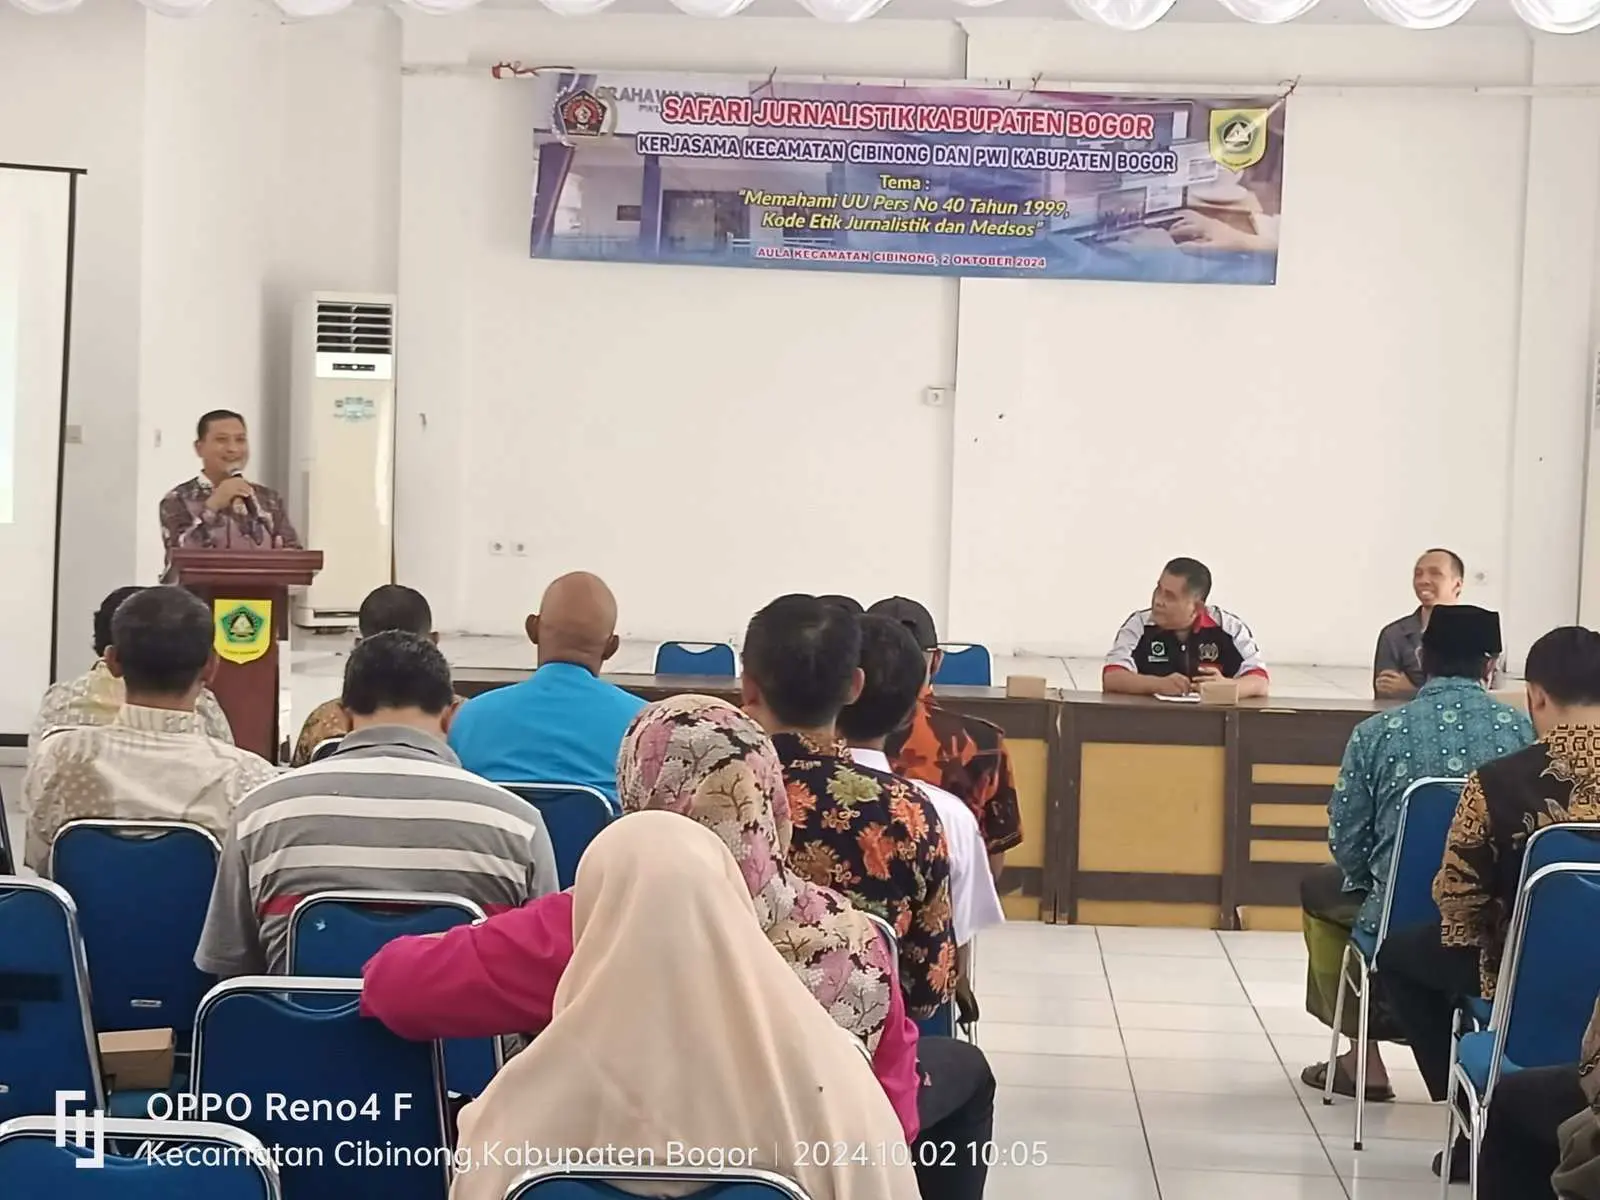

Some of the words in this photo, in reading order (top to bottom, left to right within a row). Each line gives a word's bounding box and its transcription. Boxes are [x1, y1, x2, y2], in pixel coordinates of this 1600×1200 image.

[662, 97, 749, 126] SAFARI
[754, 102, 914, 130] JURNALISTIK
[918, 106, 1063, 137] KABUPATEN
[1067, 114, 1153, 141] BOGOR
[637, 135, 739, 157] KERJASAMA
[743, 139, 845, 162] KECAMATAN
[849, 143, 929, 165] CIBINONG
[932, 148, 971, 167] DAN
[974, 151, 1008, 170] PWI
[1012, 150, 1111, 172] KABUPATEN
[1115, 153, 1178, 173] BOGOR
[879, 174, 921, 192] Tema
[841, 193, 868, 210] UU
[872, 194, 908, 212] Pers
[913, 196, 939, 213] No
[942, 198, 966, 214] 40
[969, 199, 1018, 216] Tahun
[1022, 200, 1070, 218] 1999,
[761, 213, 806, 231] Kode
[808, 214, 842, 231] Etik
[843, 216, 931, 235] Jurnalistik
[934, 218, 965, 236] dan
[757, 246, 791, 259] AULA
[793, 248, 870, 263] KECAMATAN
[872, 252, 941, 266] CIBINONG,
[942, 254, 951, 265] 2
[952, 255, 1012, 267] OKTOBER
[1014, 256, 1047, 268] 2024
